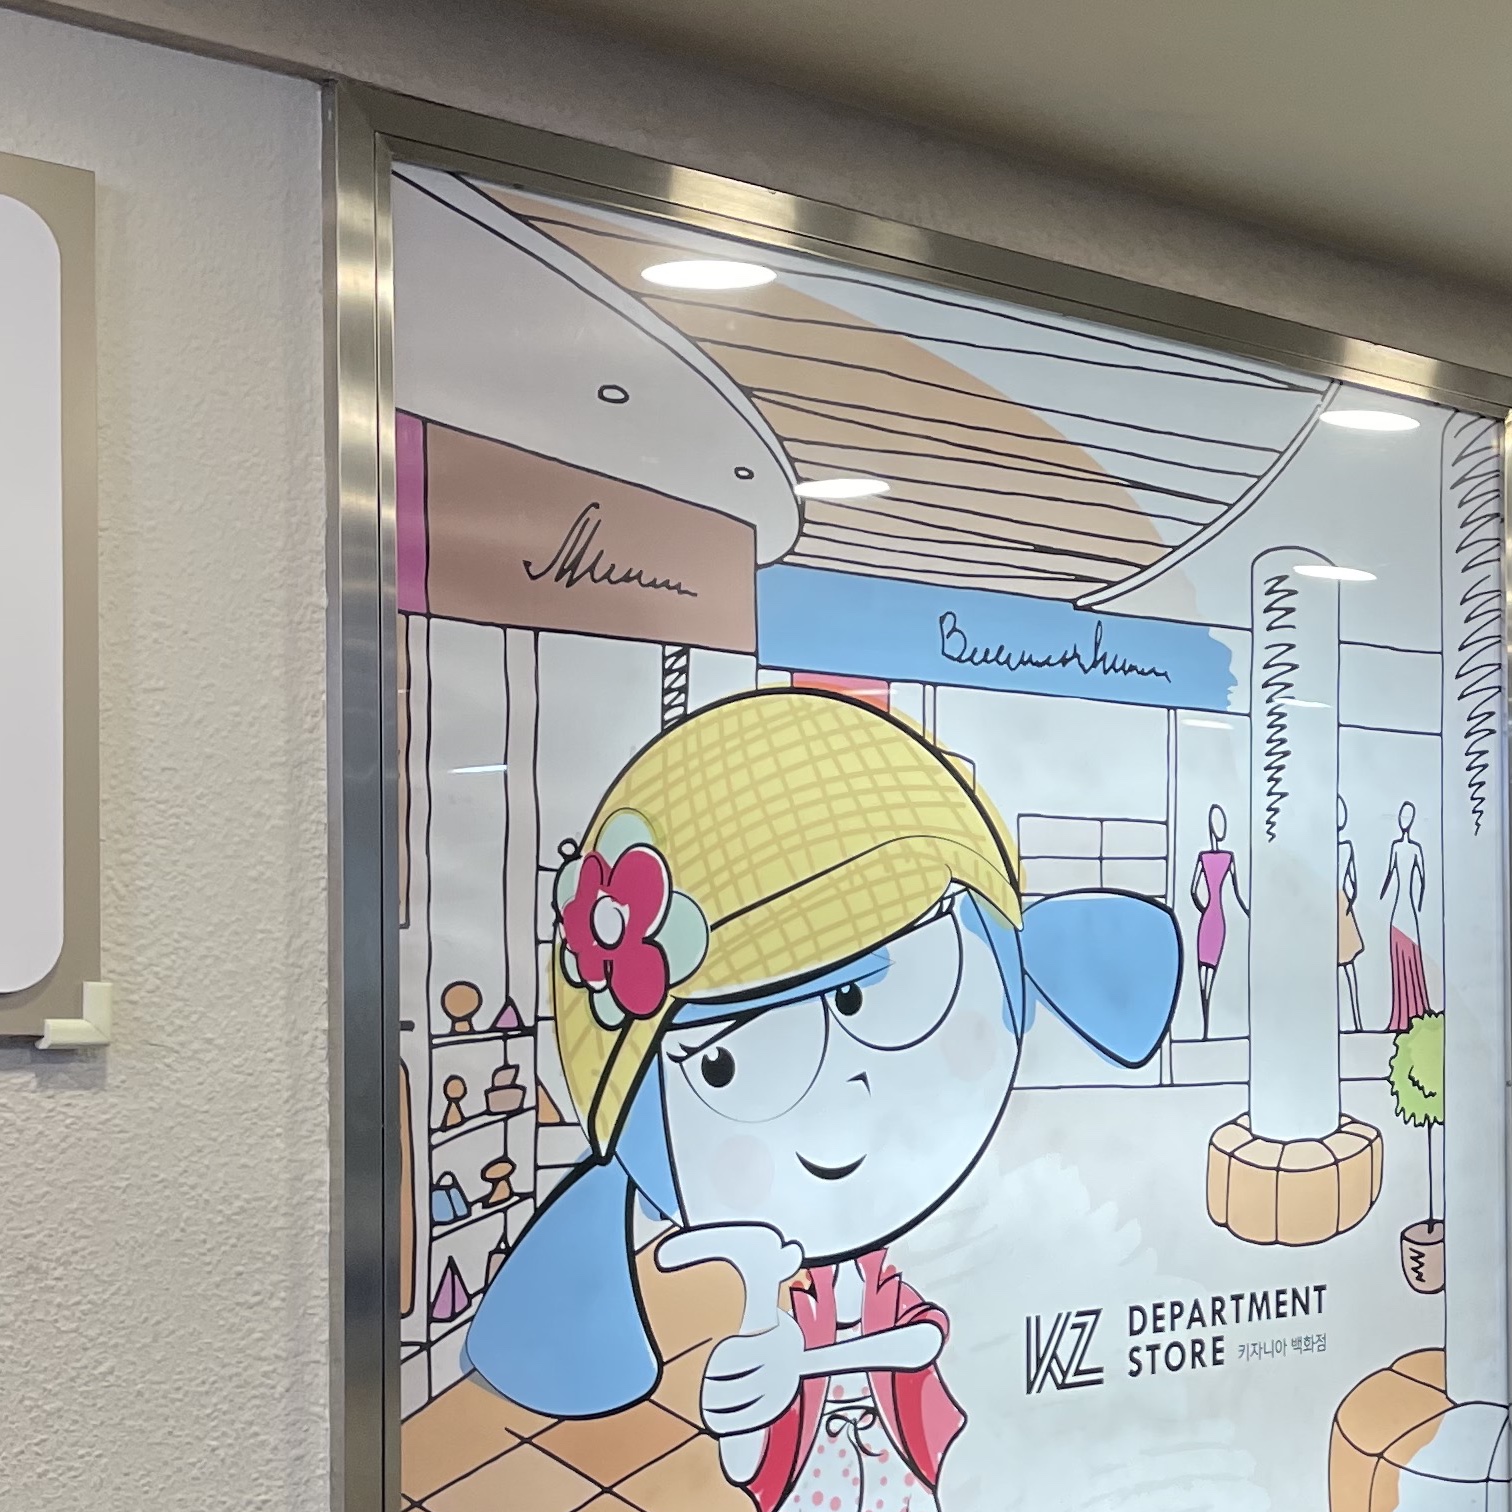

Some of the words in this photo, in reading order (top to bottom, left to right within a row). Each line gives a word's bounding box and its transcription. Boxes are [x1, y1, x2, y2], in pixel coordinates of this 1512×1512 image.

[1128, 1283, 1328, 1337] DEPARTMENT
[1025, 1307, 1104, 1395] KZ
[1128, 1335, 1225, 1377] STORE
[1238, 1337, 1288, 1362] 키자니아
[1291, 1332, 1327, 1355] 백화점
